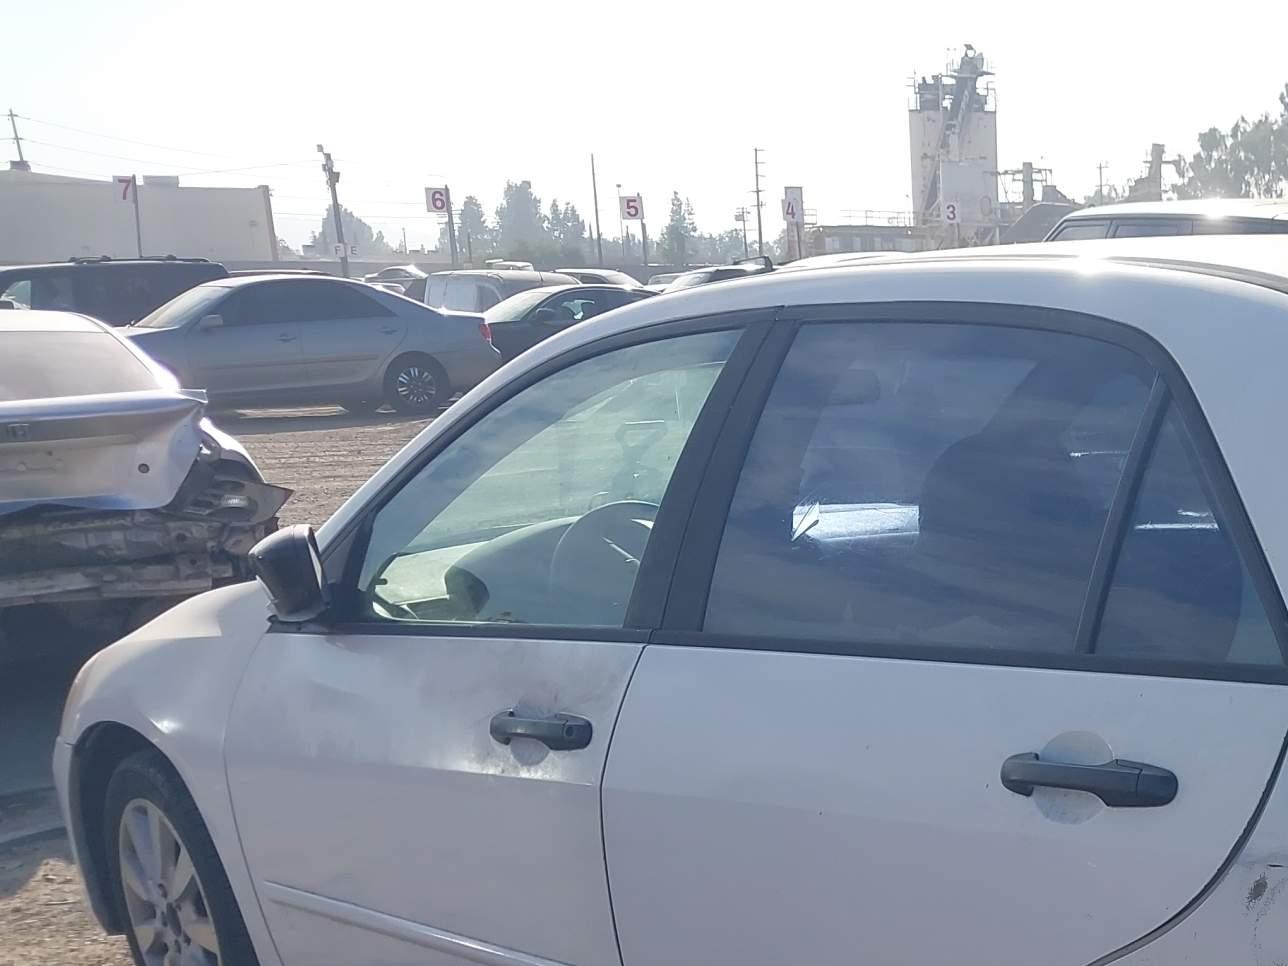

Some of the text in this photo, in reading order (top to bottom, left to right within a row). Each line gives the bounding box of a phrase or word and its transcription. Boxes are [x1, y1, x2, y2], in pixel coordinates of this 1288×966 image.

[117, 178, 132, 201] 7
[431, 190, 446, 210] 6
[625, 198, 639, 217] 5
[786, 201, 796, 219] 4
[946, 204, 957, 221] 3
